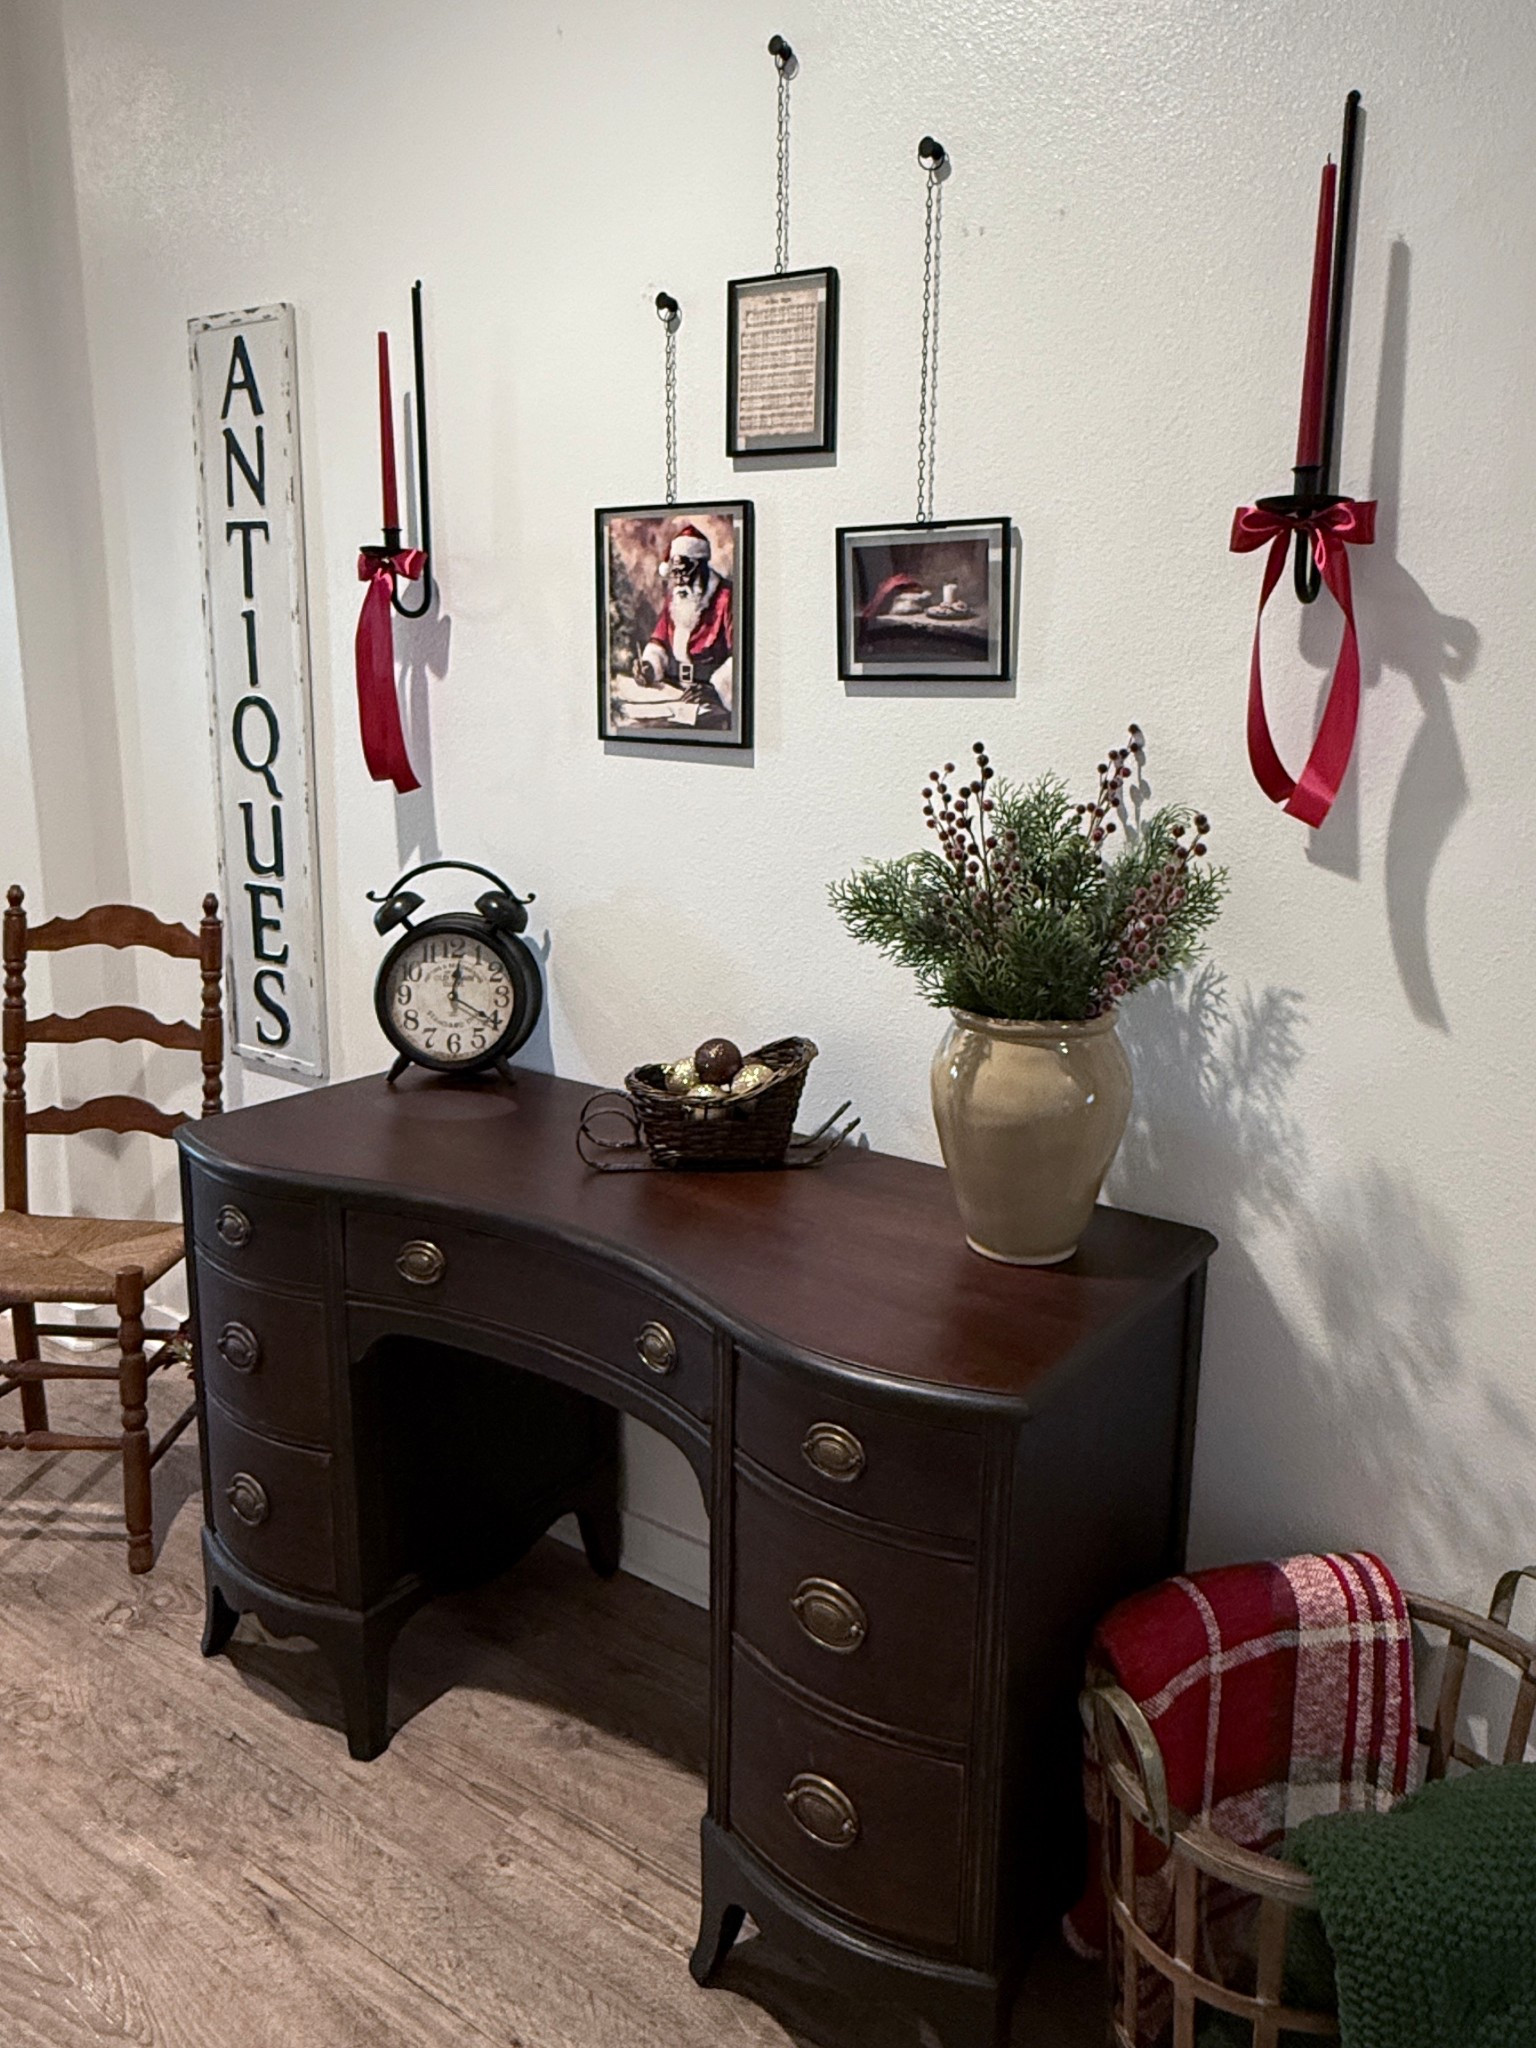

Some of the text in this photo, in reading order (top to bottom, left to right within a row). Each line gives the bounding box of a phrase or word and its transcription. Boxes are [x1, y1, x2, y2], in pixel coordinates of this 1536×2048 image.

[221, 334, 291, 1046] ANTIQUES
[422, 943, 436, 963] 11
[442, 937, 466, 958] 12
[474, 945, 482, 965] 1
[403, 961, 423, 982] 10
[488, 961, 503, 983] 2
[397, 984, 412, 1006] 9
[493, 985, 510, 1008] 3
[403, 1009, 420, 1031] 8
[488, 1009, 503, 1031] 4
[422, 1027, 438, 1048] 7
[446, 1032, 462, 1054] 6
[471, 1028, 486, 1049] 5
